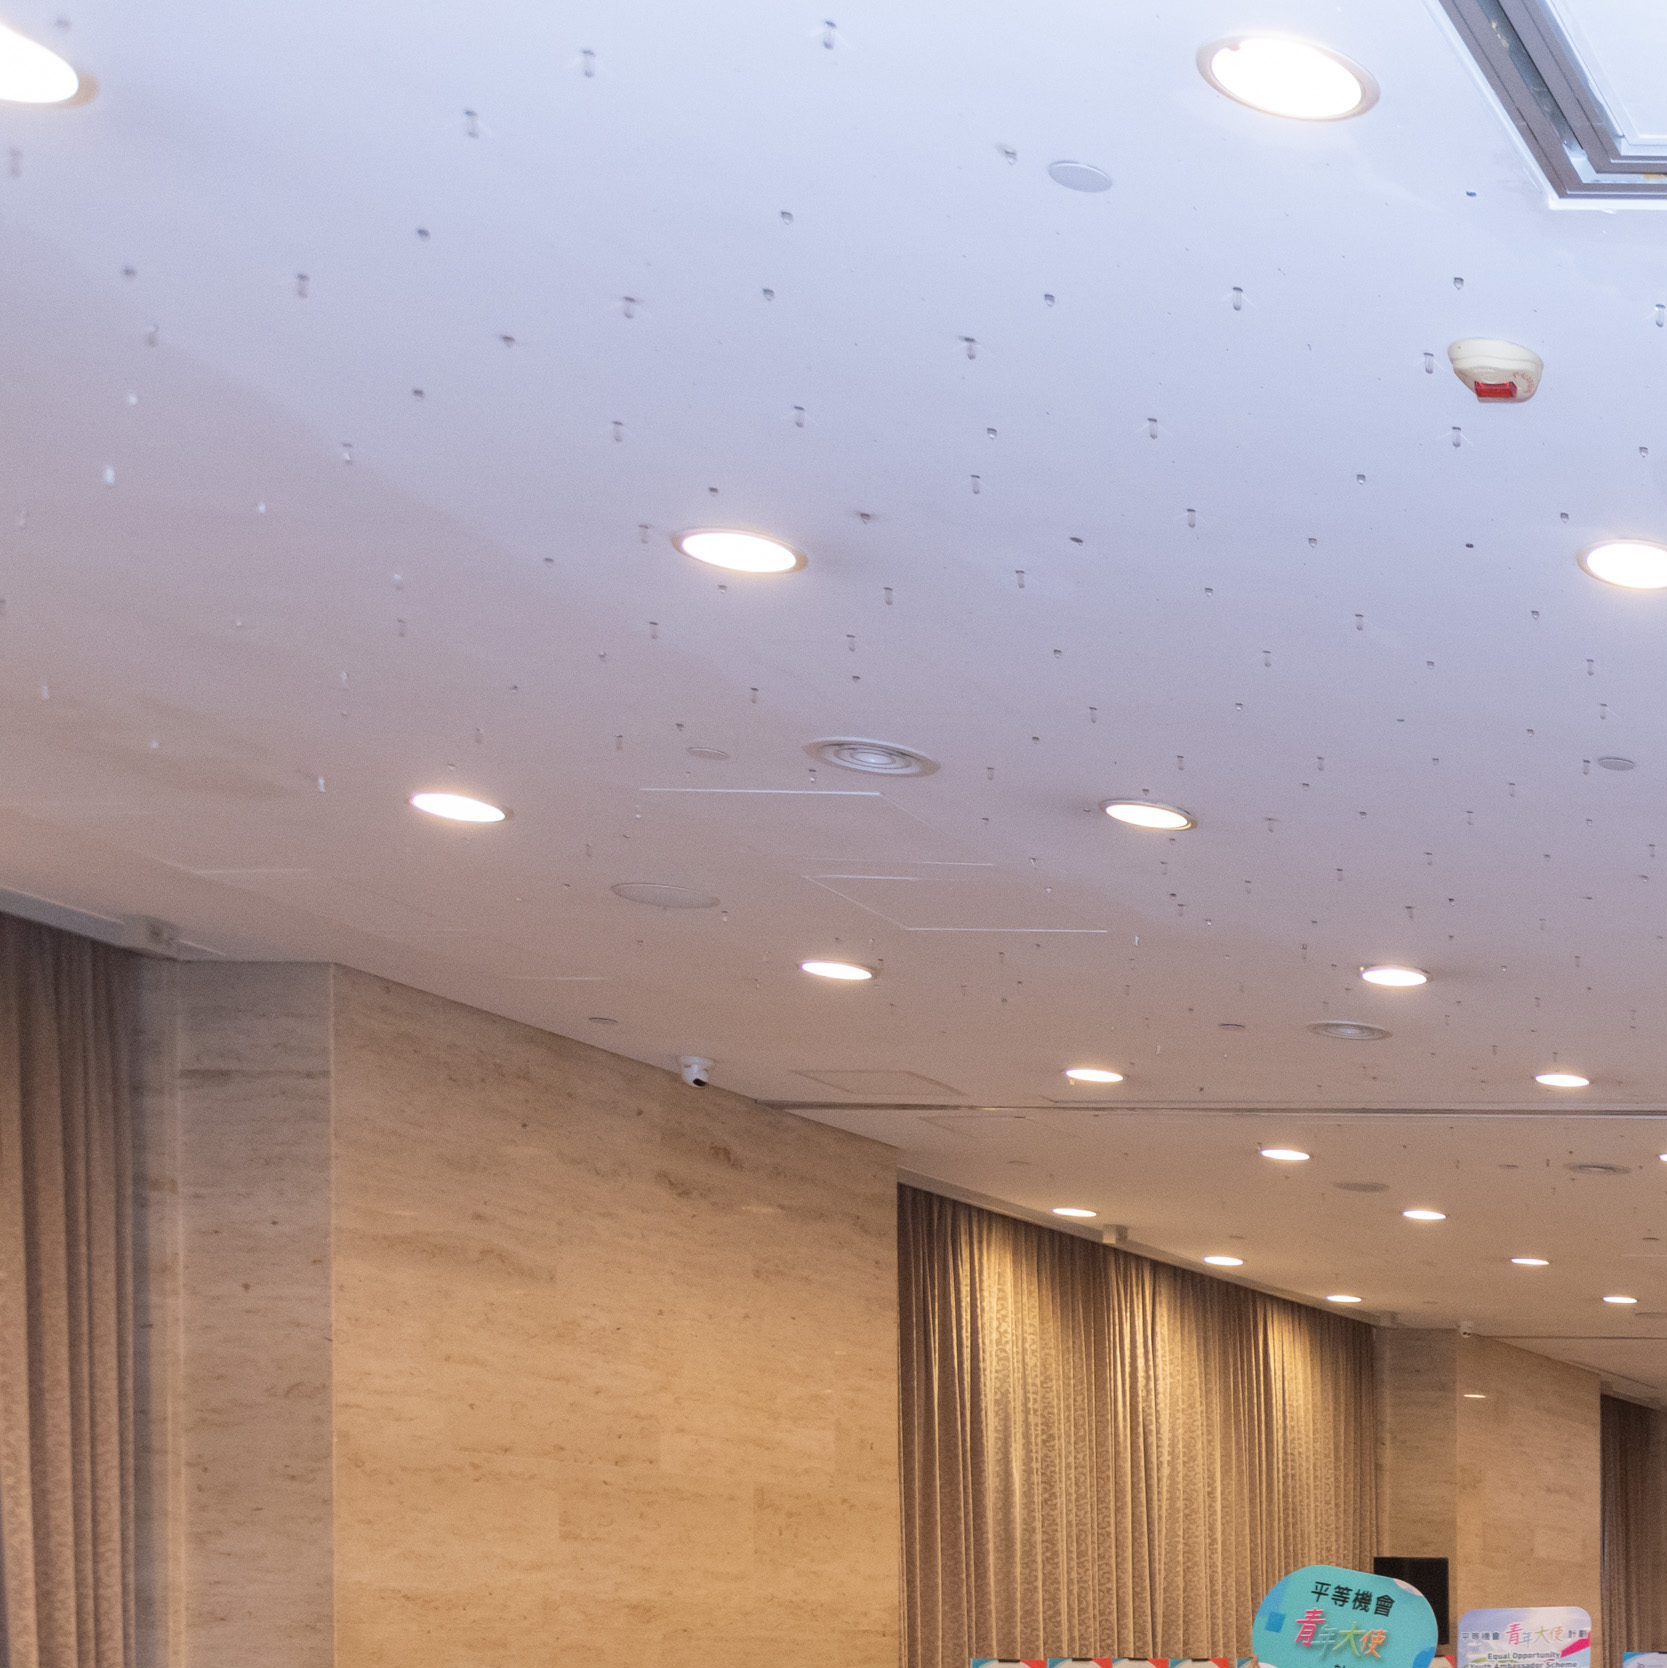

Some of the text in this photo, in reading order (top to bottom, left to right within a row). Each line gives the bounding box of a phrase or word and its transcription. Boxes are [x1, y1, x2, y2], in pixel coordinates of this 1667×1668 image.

[1310, 1580, 1396, 1618] 平等機會
[1294, 1607, 1389, 1660] 青年大使
[1487, 1651, 1560, 1661] Equal Opportunity
[1546, 1661, 1578, 1668] Scheme
